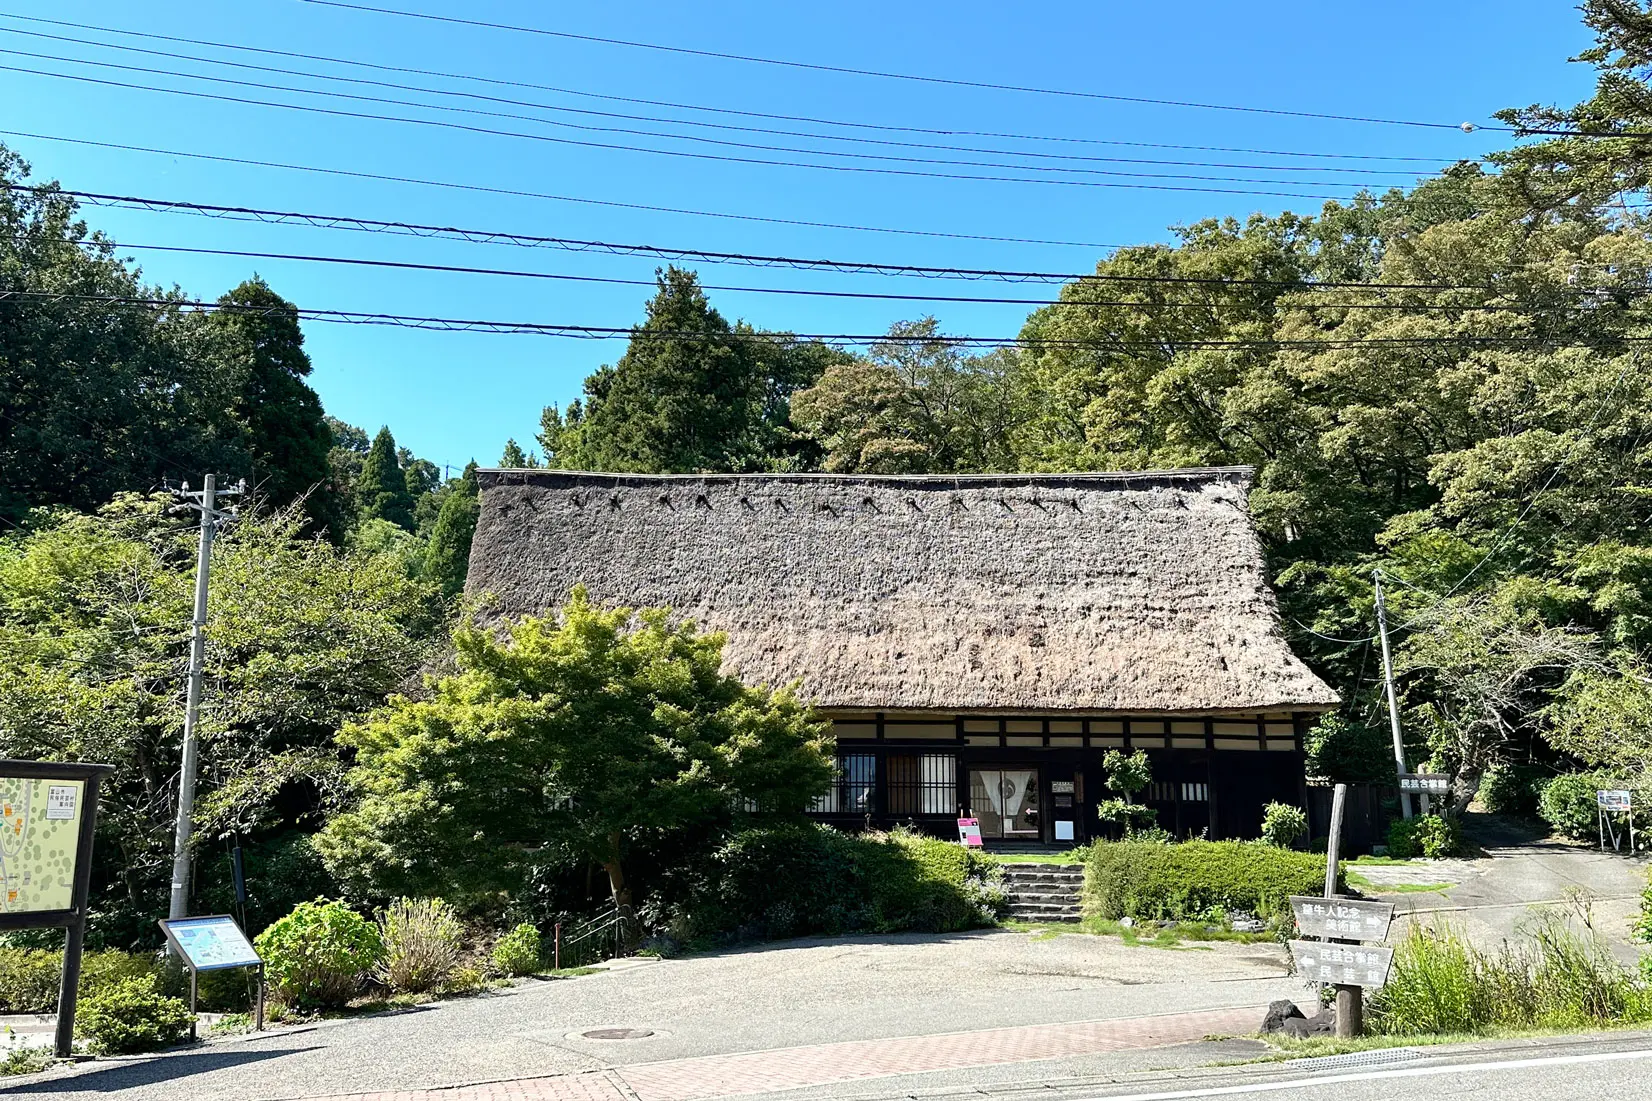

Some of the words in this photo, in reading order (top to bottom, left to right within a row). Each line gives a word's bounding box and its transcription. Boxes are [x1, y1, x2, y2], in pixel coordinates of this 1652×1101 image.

[1401, 779, 1448, 789] 民芸合掌館
[1326, 918, 1361, 933] 美術館
[1320, 948, 1379, 965] 民芸合掌館
